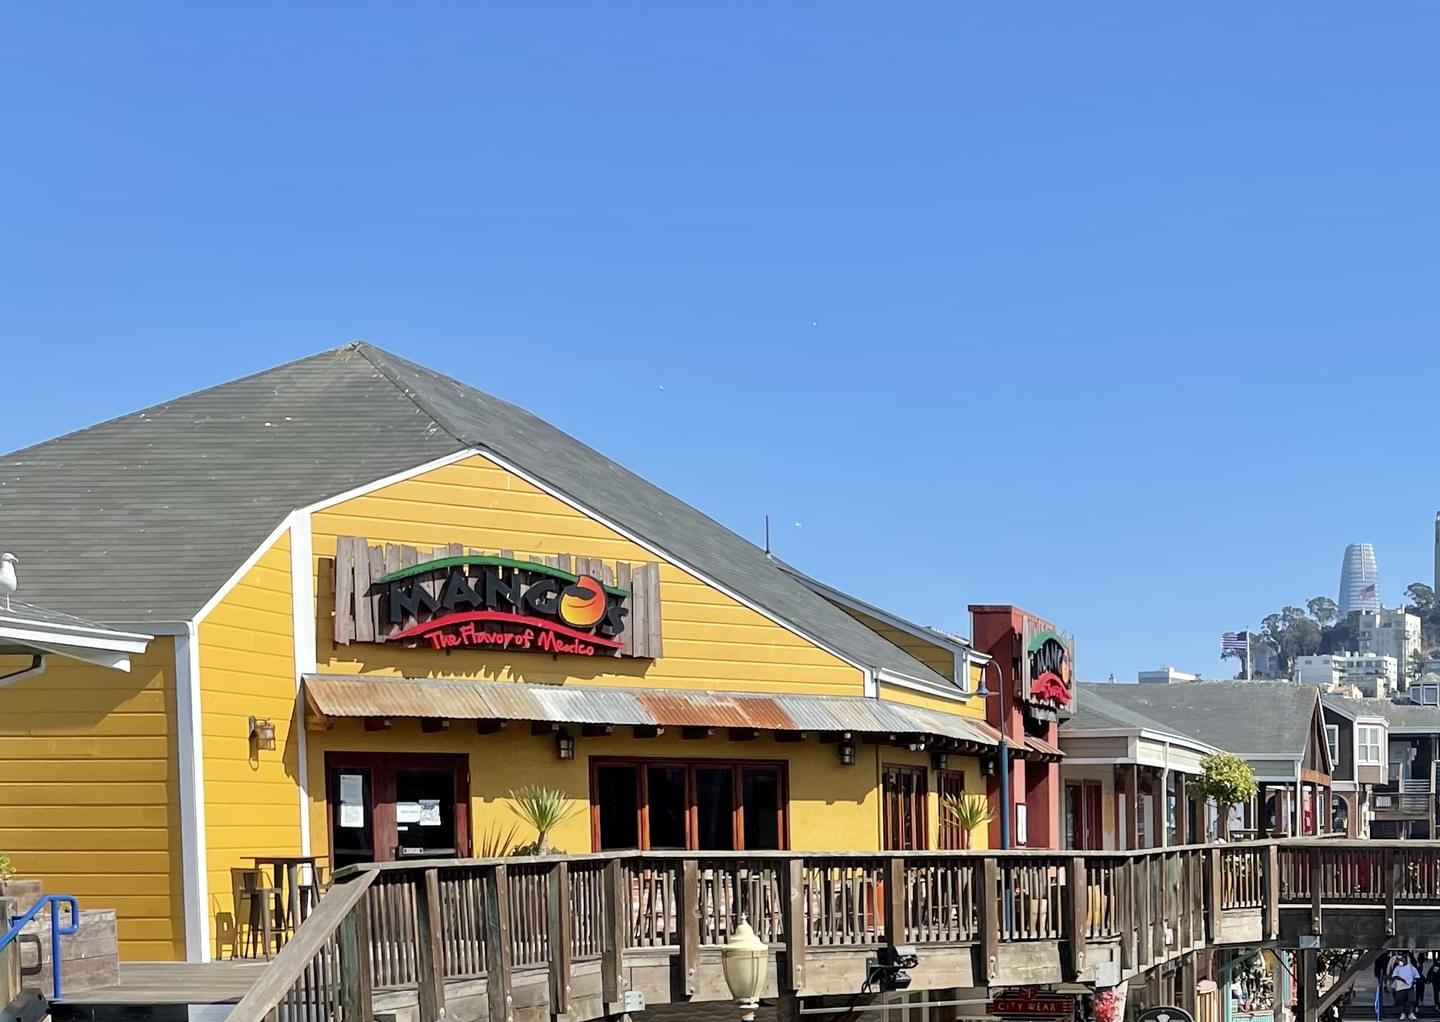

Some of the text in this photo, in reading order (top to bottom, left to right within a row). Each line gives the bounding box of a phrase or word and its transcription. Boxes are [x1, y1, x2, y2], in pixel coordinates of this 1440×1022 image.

[426, 622, 595, 657] The Flavor of Mexico
[998, 1002, 1057, 1012] CITY WEAR
